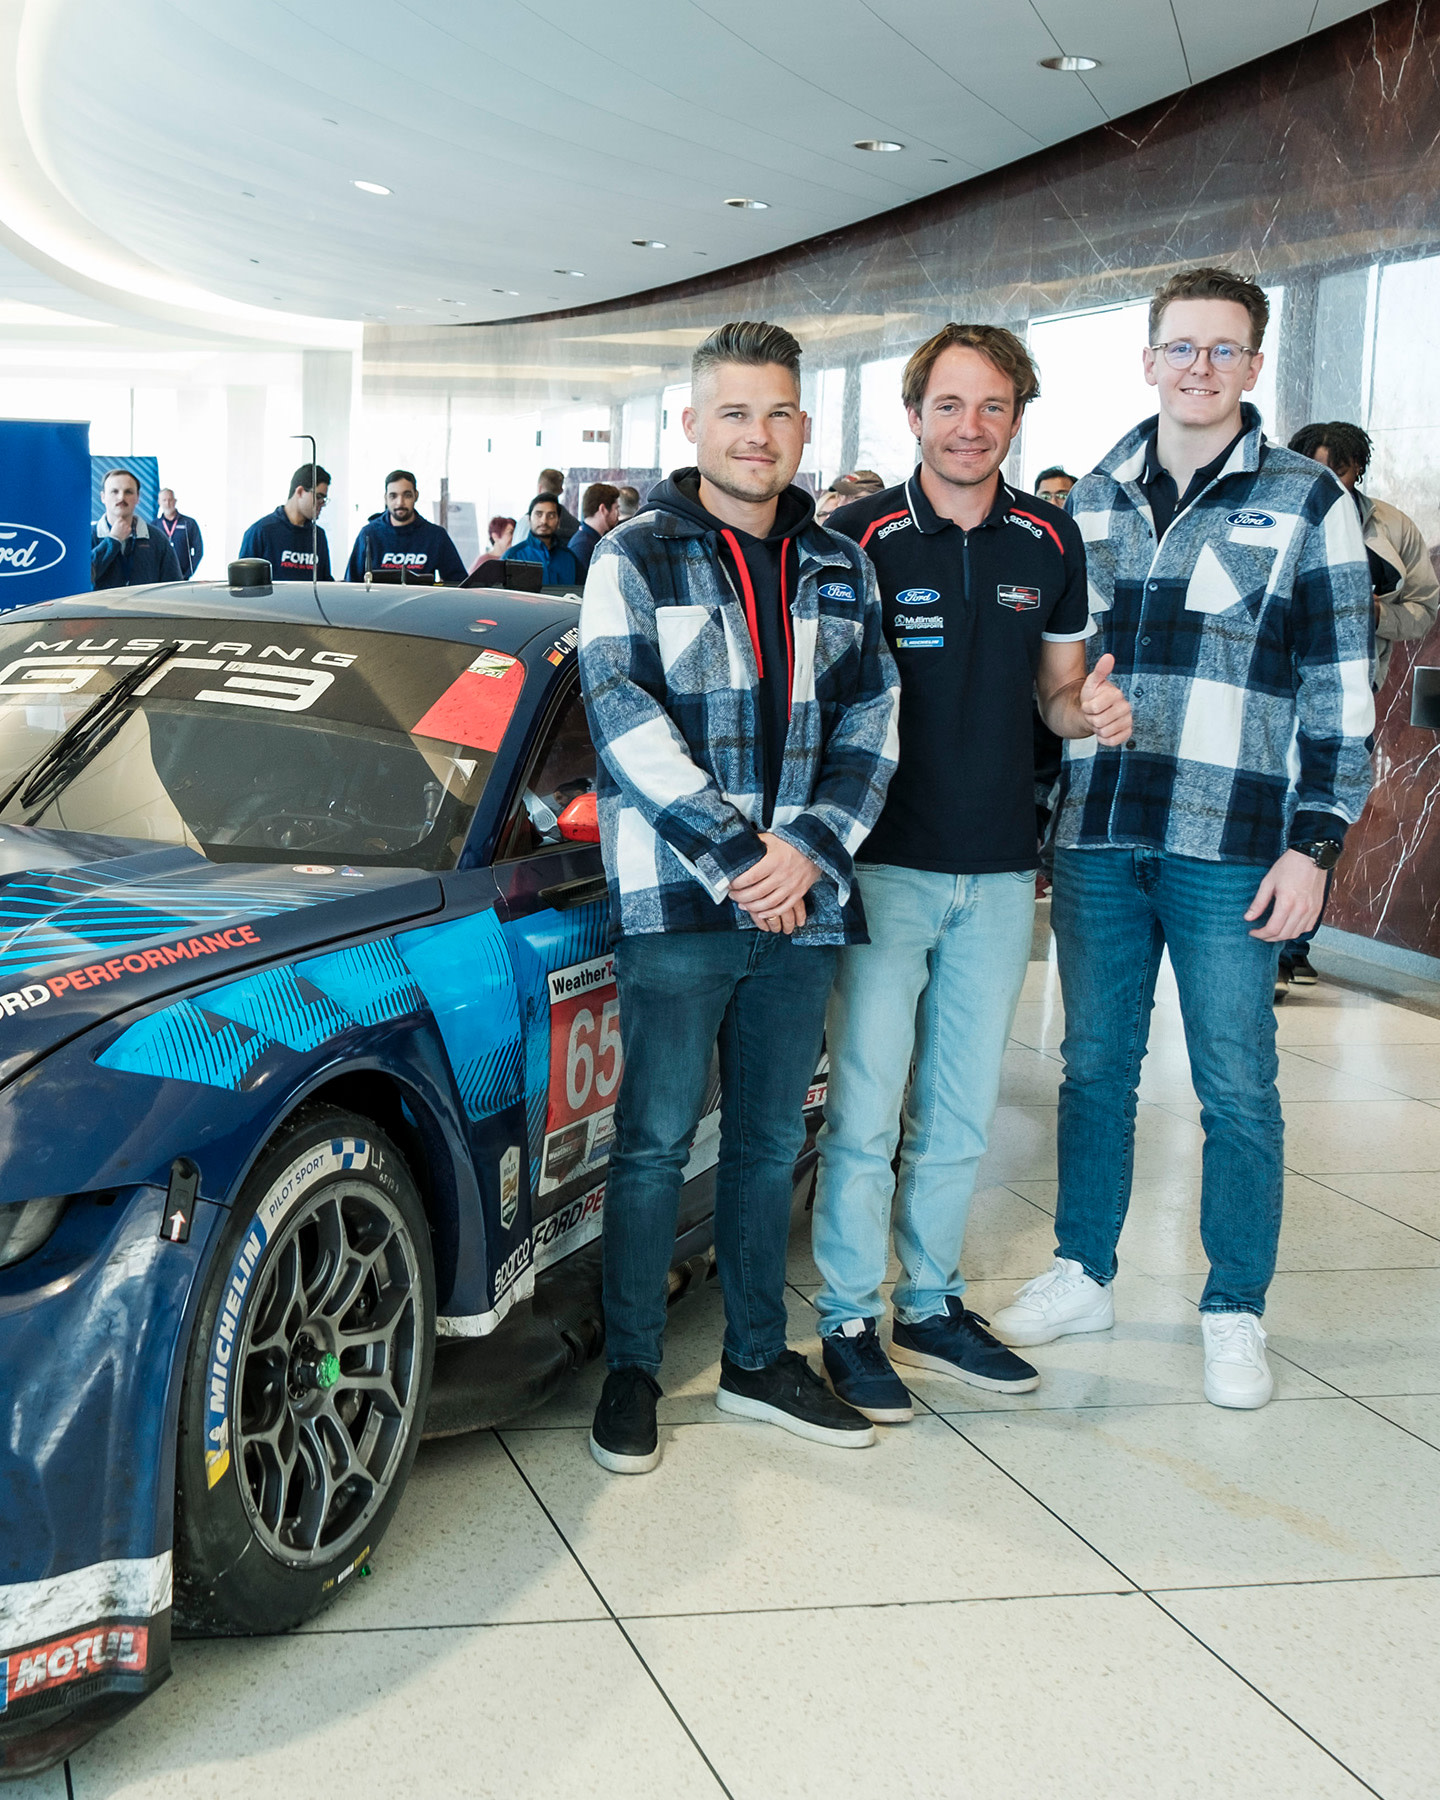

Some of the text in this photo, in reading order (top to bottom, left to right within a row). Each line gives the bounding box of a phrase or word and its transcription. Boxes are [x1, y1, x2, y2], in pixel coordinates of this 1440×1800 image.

[877, 517, 913, 540] sparco
[1233, 512, 1267, 525] Ford
[281, 550, 319, 566] FORD
[382, 552, 428, 566] FORD
[827, 584, 852, 599] Ford
[904, 590, 932, 602] Ford
[24, 638, 359, 668] MUSTANG
[0, 654, 336, 712] GT3
[0, 925, 262, 1021] RDPERFORMANCE
[552, 960, 614, 996] WeatherT
[566, 998, 624, 1110] 65
[269, 1154, 325, 1218] PILOT SPORT
[494, 1238, 530, 1297] sparco
[210, 1231, 261, 1414] MICHELIN
[13, 1631, 139, 1693] MOTUL
